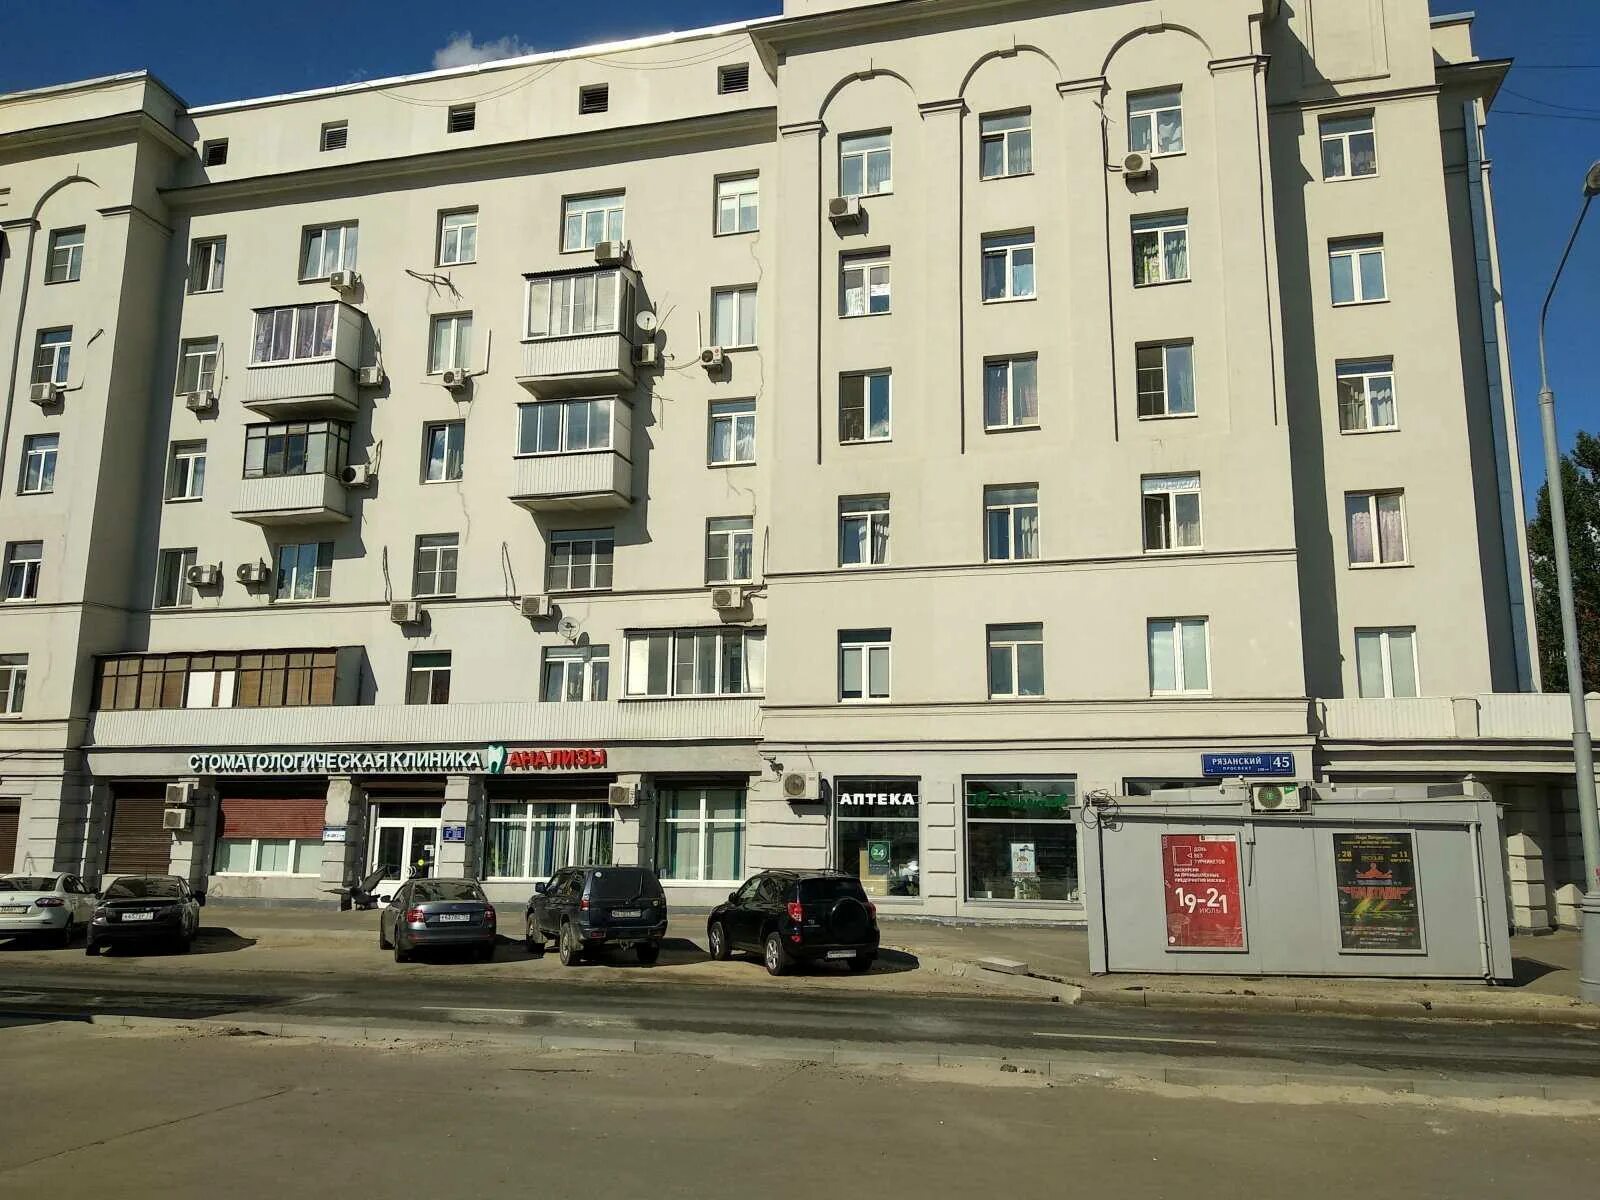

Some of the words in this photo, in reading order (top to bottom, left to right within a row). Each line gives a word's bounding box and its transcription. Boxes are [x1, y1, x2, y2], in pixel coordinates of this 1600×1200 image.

[188, 752, 387, 770] СТОМАТОЛОГИЧЕСКАЯ
[391, 751, 482, 769] КЛИНИКА
[509, 749, 607, 769] АНАЛИЗЫ
[1212, 756, 1262, 766] РЯЗАНСКИЙ
[1272, 756, 1290, 768] 45
[840, 793, 915, 806] АПТЕКА
[872, 848, 884, 857] 24
